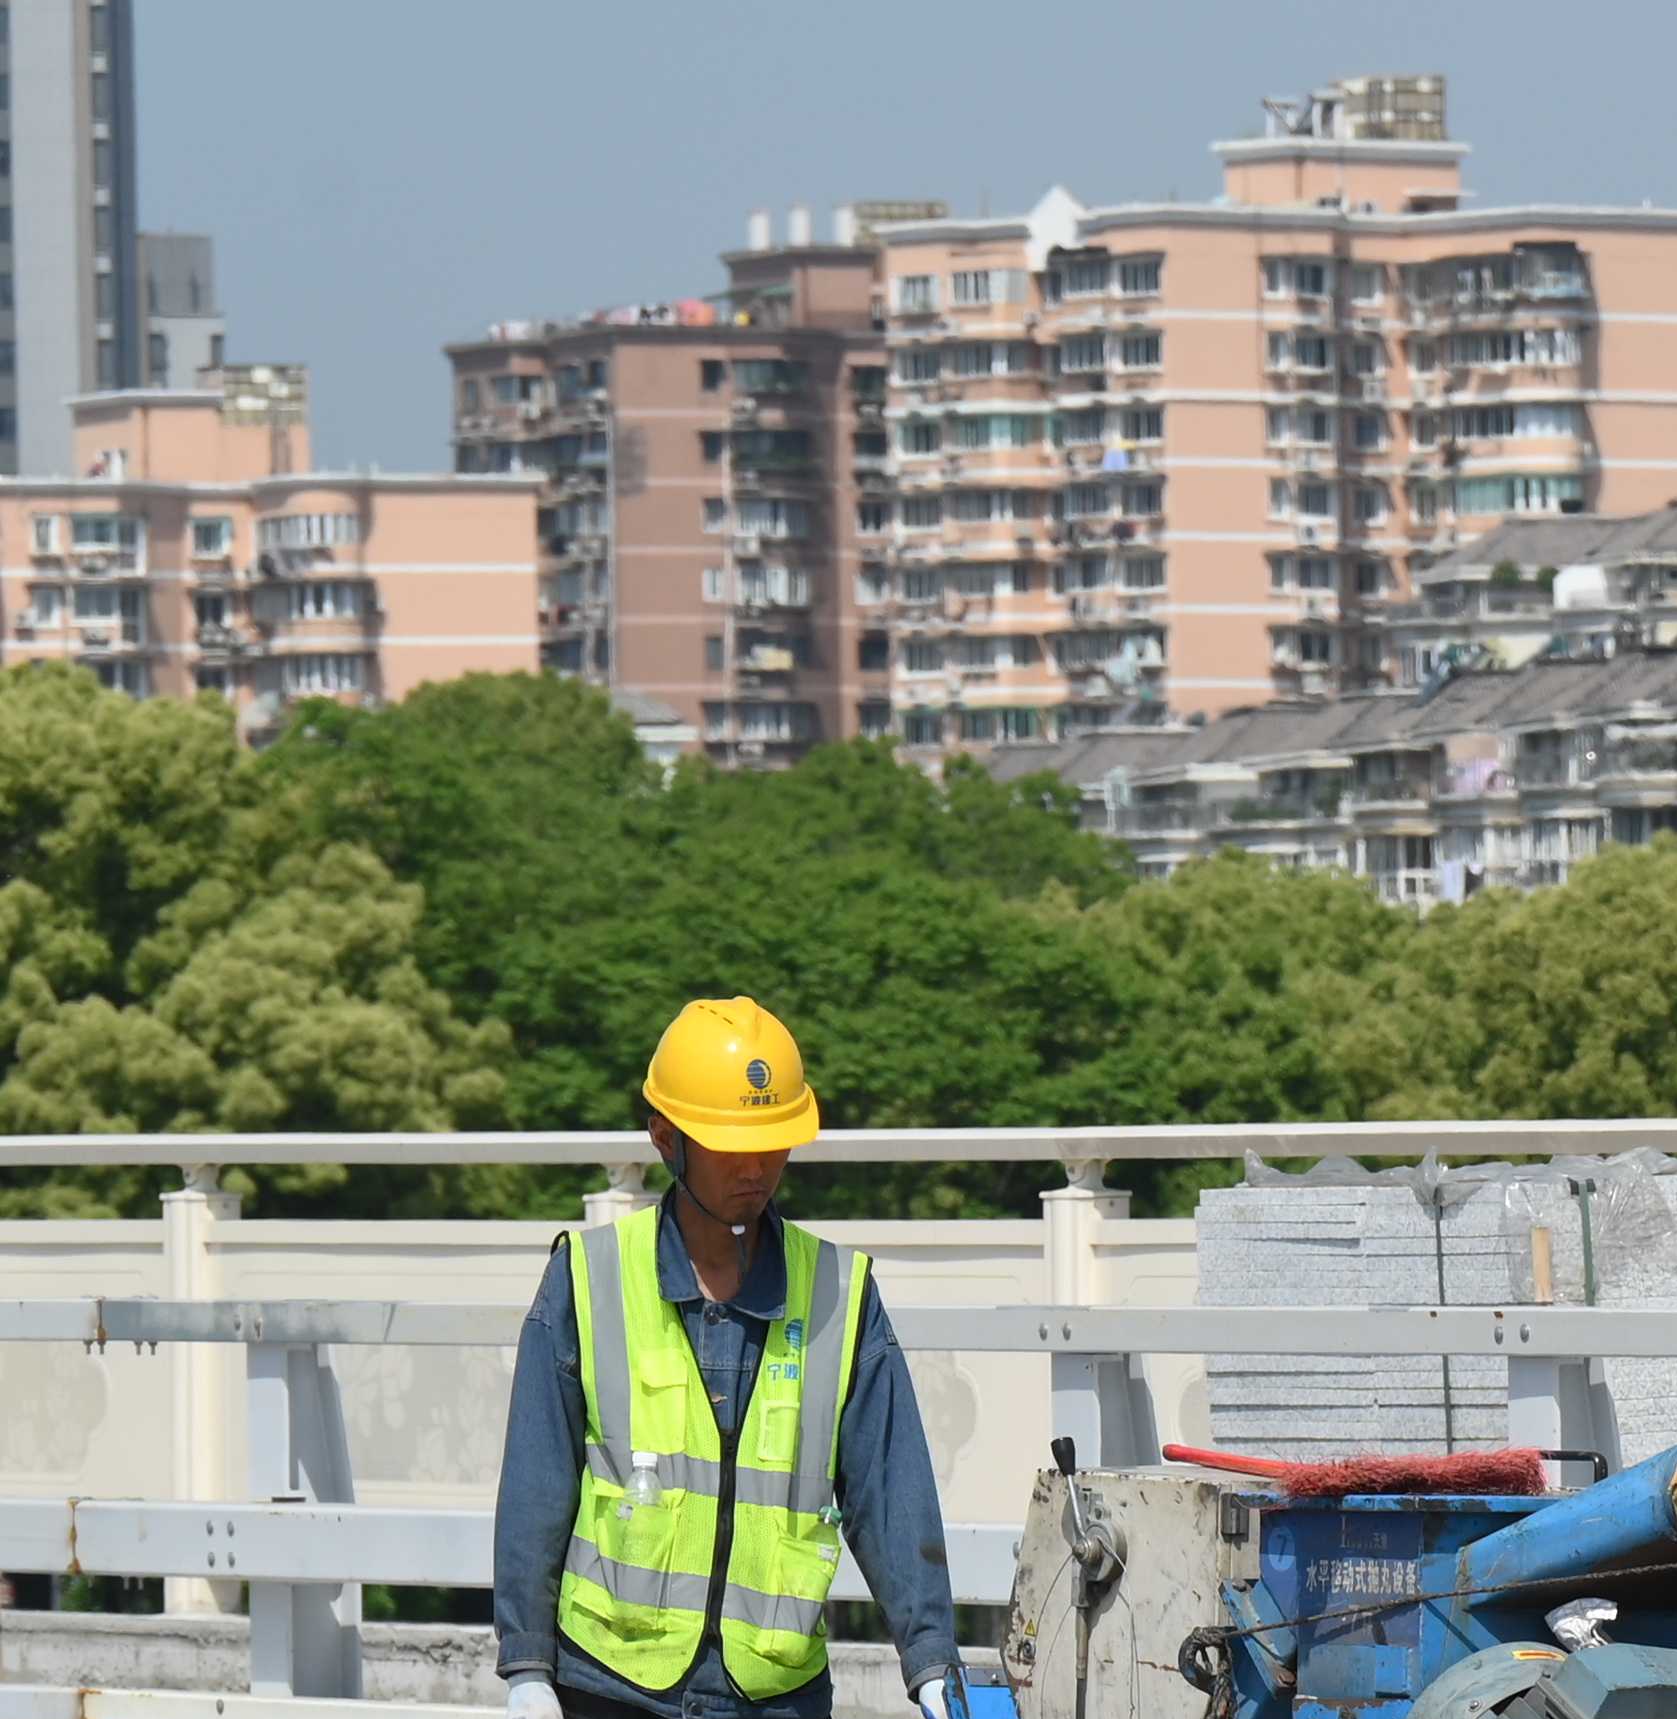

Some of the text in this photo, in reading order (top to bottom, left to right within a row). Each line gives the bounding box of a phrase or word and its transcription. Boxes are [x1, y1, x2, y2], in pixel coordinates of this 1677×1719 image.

[1306, 1559, 1417, 1595] 水平移动式抛丸设备
